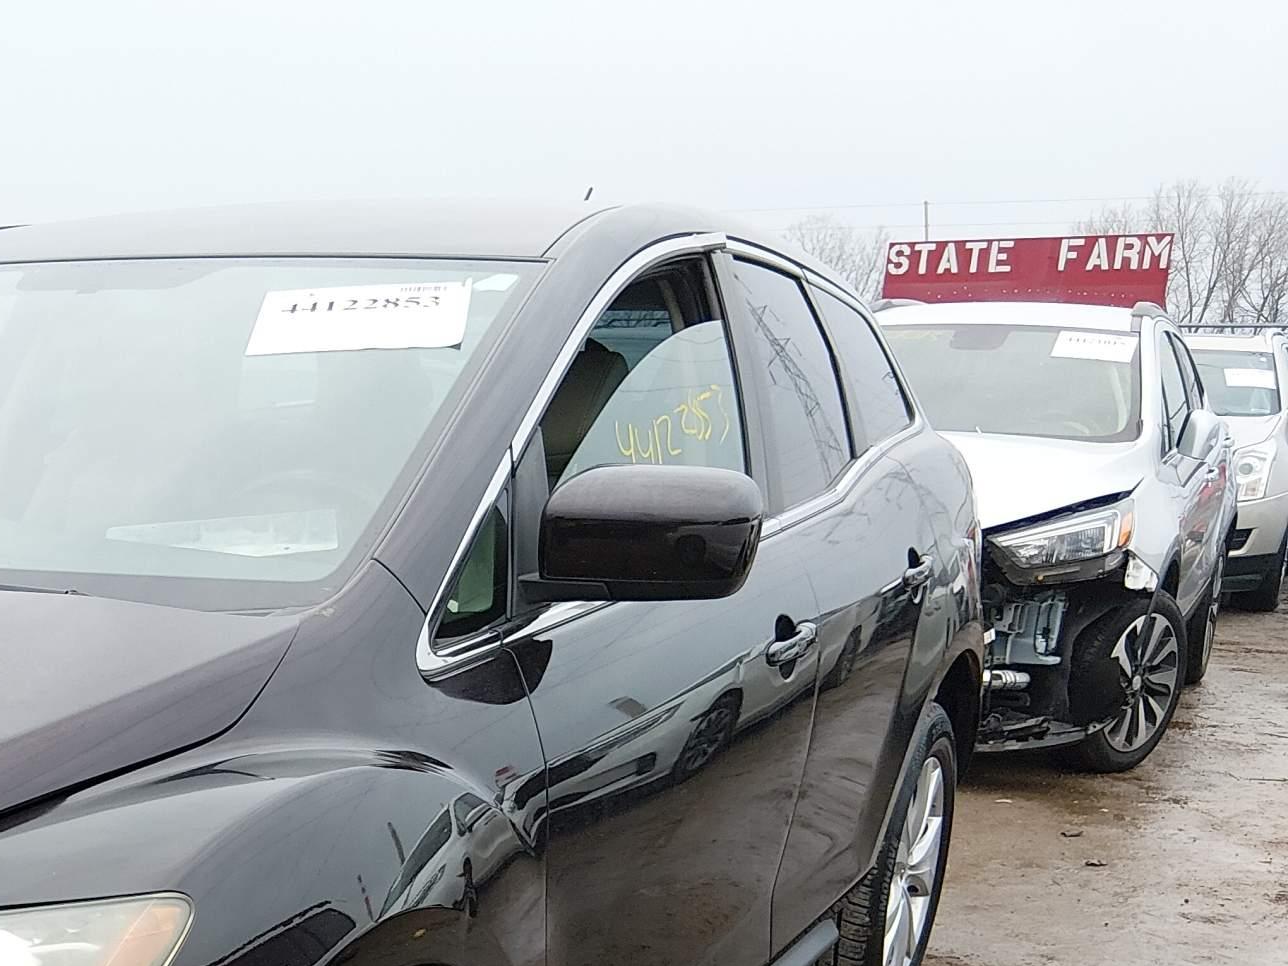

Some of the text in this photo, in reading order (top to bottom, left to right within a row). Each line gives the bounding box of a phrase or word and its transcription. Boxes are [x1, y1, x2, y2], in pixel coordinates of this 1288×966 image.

[887, 235, 1172, 276] STATE FARM
[281, 295, 440, 314] 44122853
